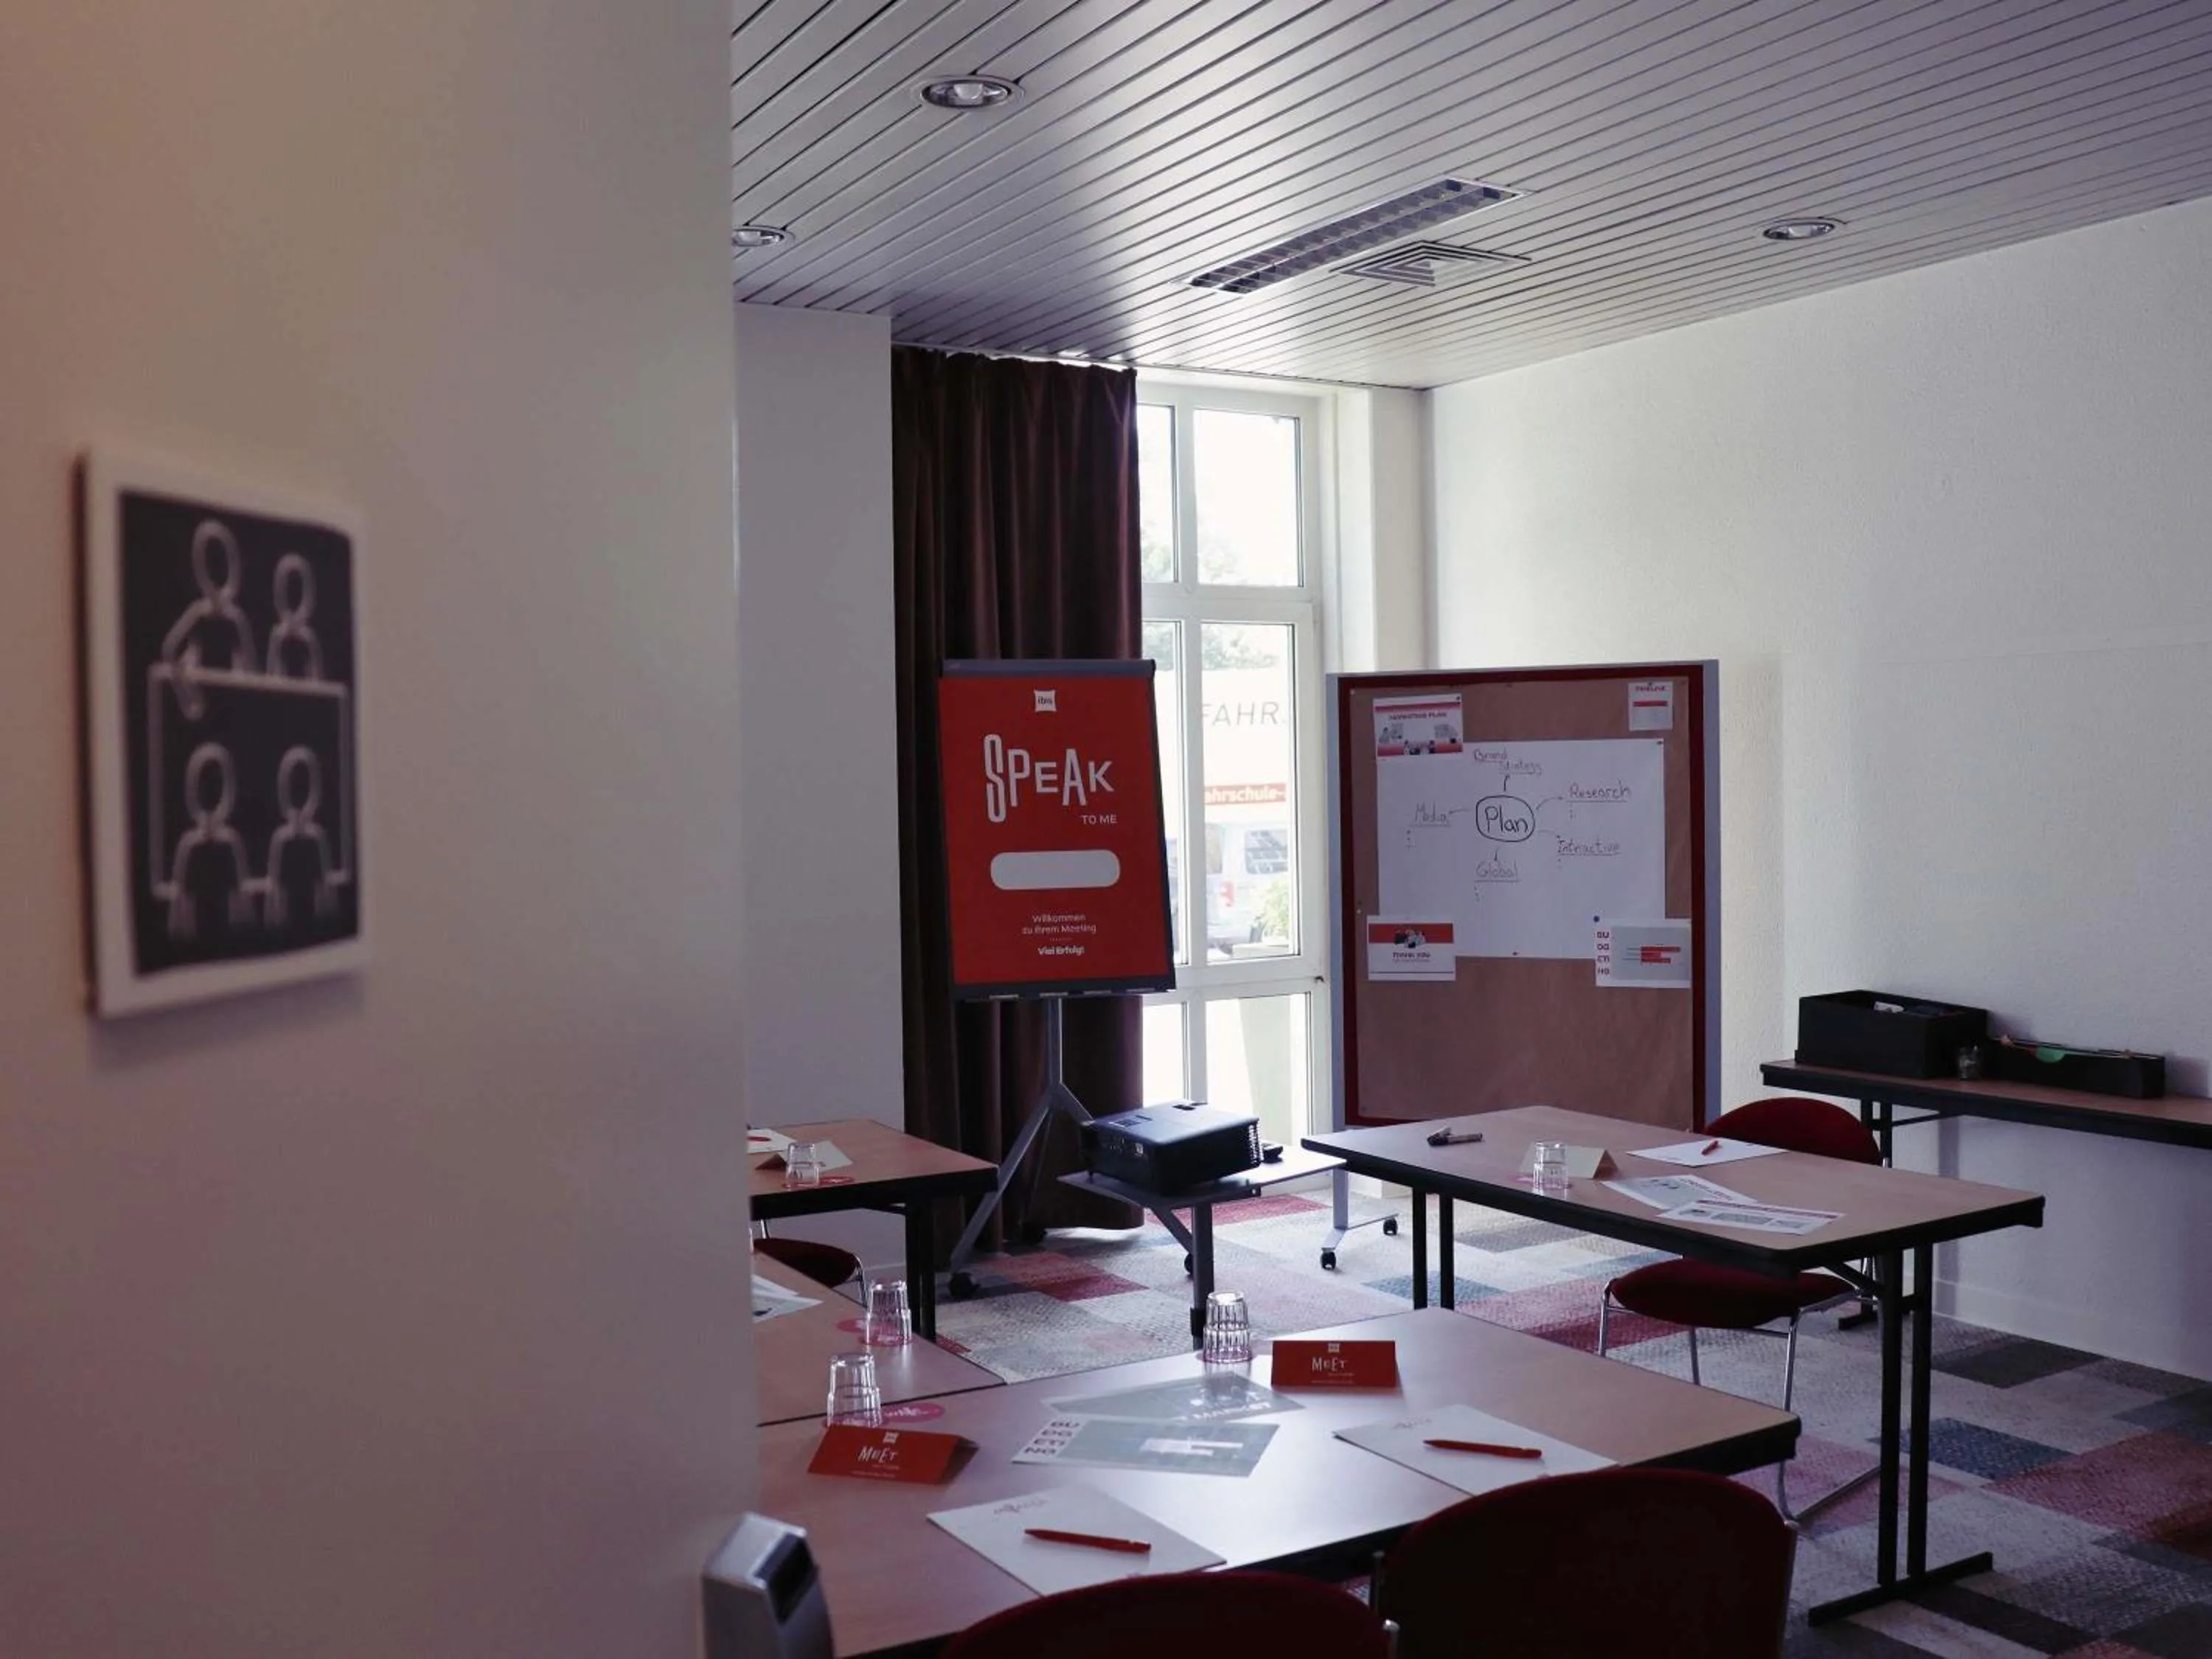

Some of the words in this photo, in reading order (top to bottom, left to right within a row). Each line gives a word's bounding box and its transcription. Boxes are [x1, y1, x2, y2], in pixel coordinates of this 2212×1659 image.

[984, 734, 1115, 823] SPEAK
[1568, 779, 1632, 799] Research
[1081, 815, 1096, 824] TO
[1099, 814, 1118, 824] ME
[1484, 804, 1528, 833] Plan
